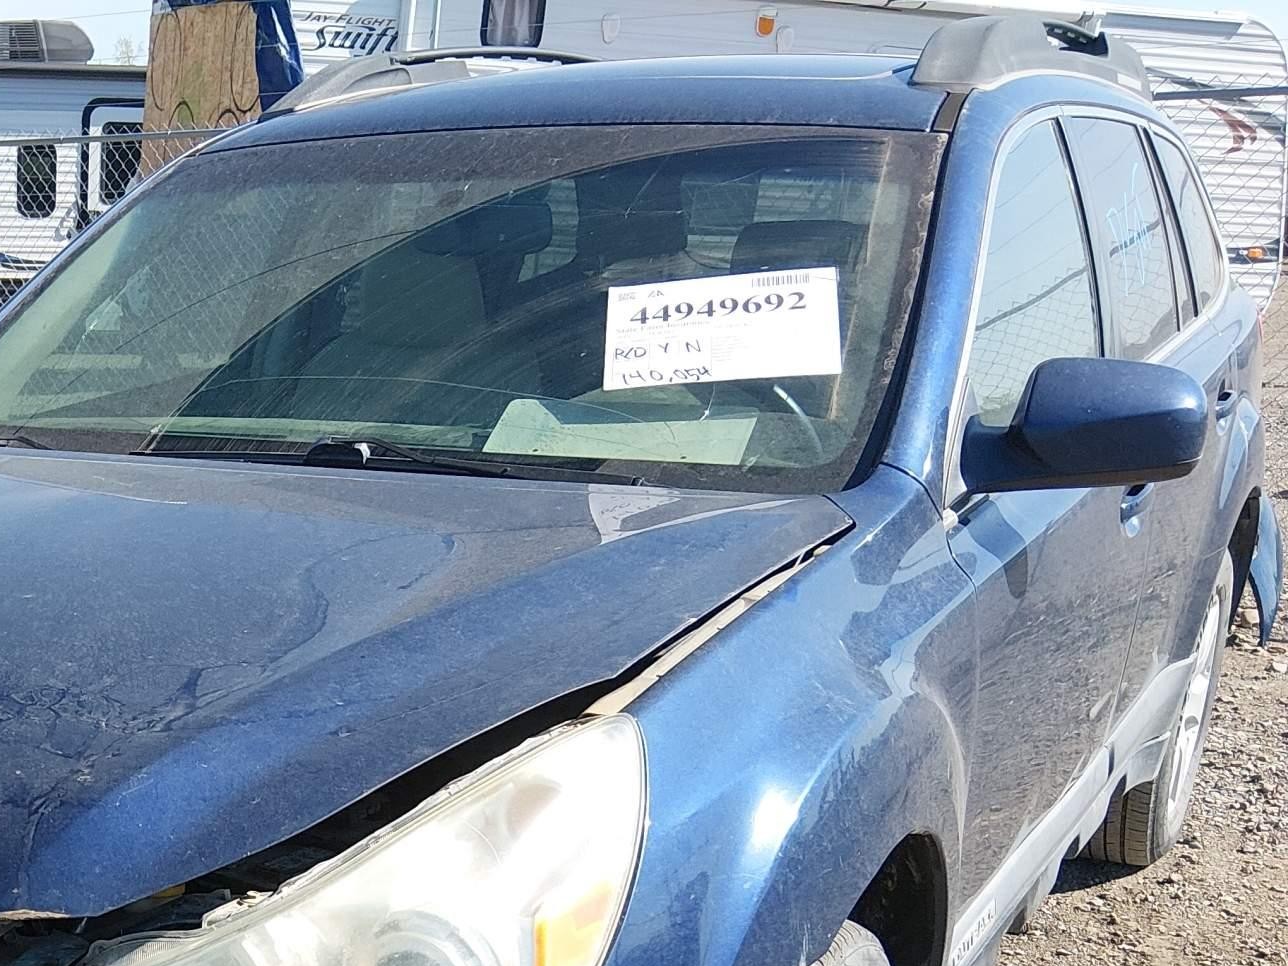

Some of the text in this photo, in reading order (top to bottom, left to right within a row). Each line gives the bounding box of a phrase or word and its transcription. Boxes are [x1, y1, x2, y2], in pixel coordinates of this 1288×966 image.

[300, 12, 397, 26] JAY FLIGHT
[305, 25, 399, 56] Swift
[630, 292, 807, 324] 44949692
[658, 343, 669, 354] Y
[686, 339, 702, 353] N
